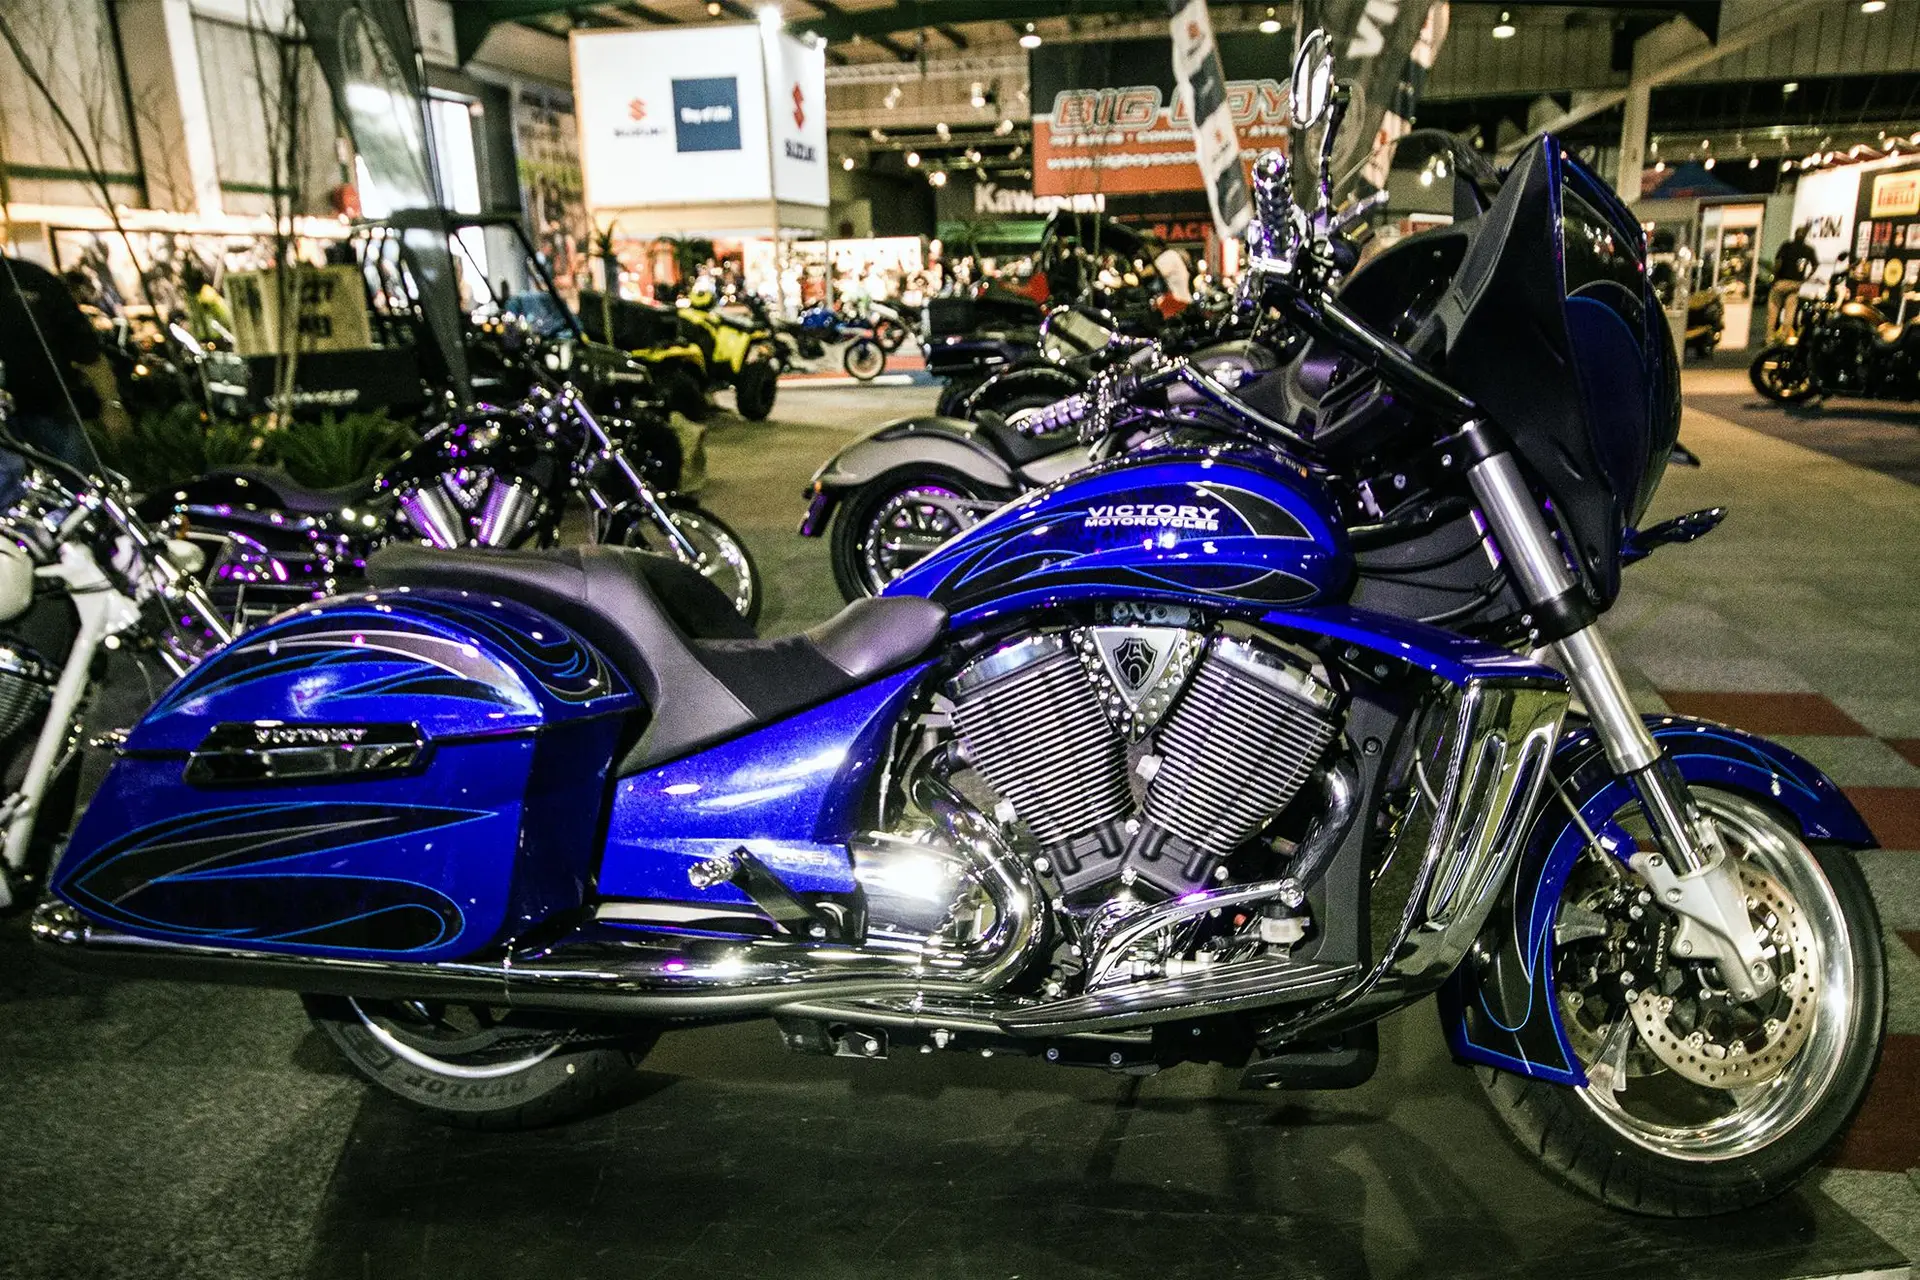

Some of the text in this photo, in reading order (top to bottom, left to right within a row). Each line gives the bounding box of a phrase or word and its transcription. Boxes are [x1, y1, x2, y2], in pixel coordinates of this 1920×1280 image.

[1052, 85, 1162, 134] BIG
[1087, 504, 1220, 521] VICTORY
[1084, 517, 1219, 531] MOTORCYCLES
[254, 728, 368, 744] VICTORY
[1653, 921, 1667, 973] VICTORY
